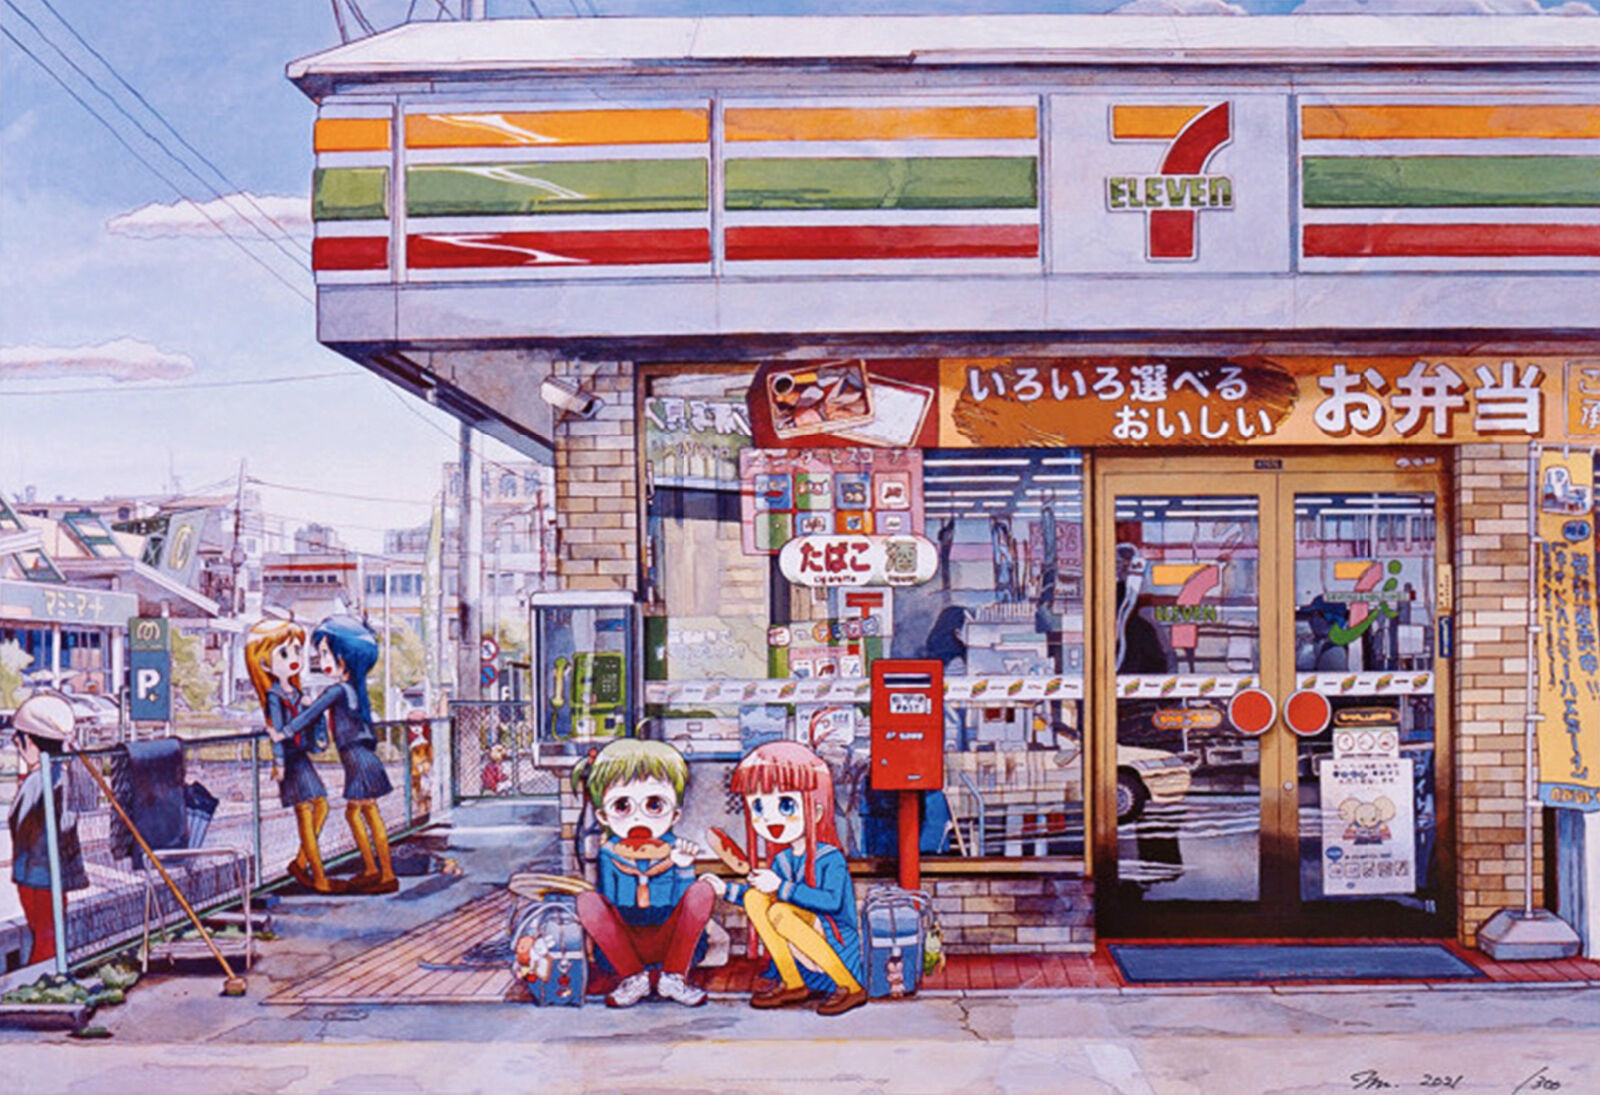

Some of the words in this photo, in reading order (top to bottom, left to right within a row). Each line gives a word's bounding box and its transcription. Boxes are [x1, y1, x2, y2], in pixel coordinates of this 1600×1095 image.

[969, 363, 1249, 402] いろいろ選べる
[1314, 360, 1543, 435] お弁当
[1111, 404, 1275, 440] おいしい
[800, 541, 872, 573] たばこ
[1420, 1073, 1464, 1090] 2021
